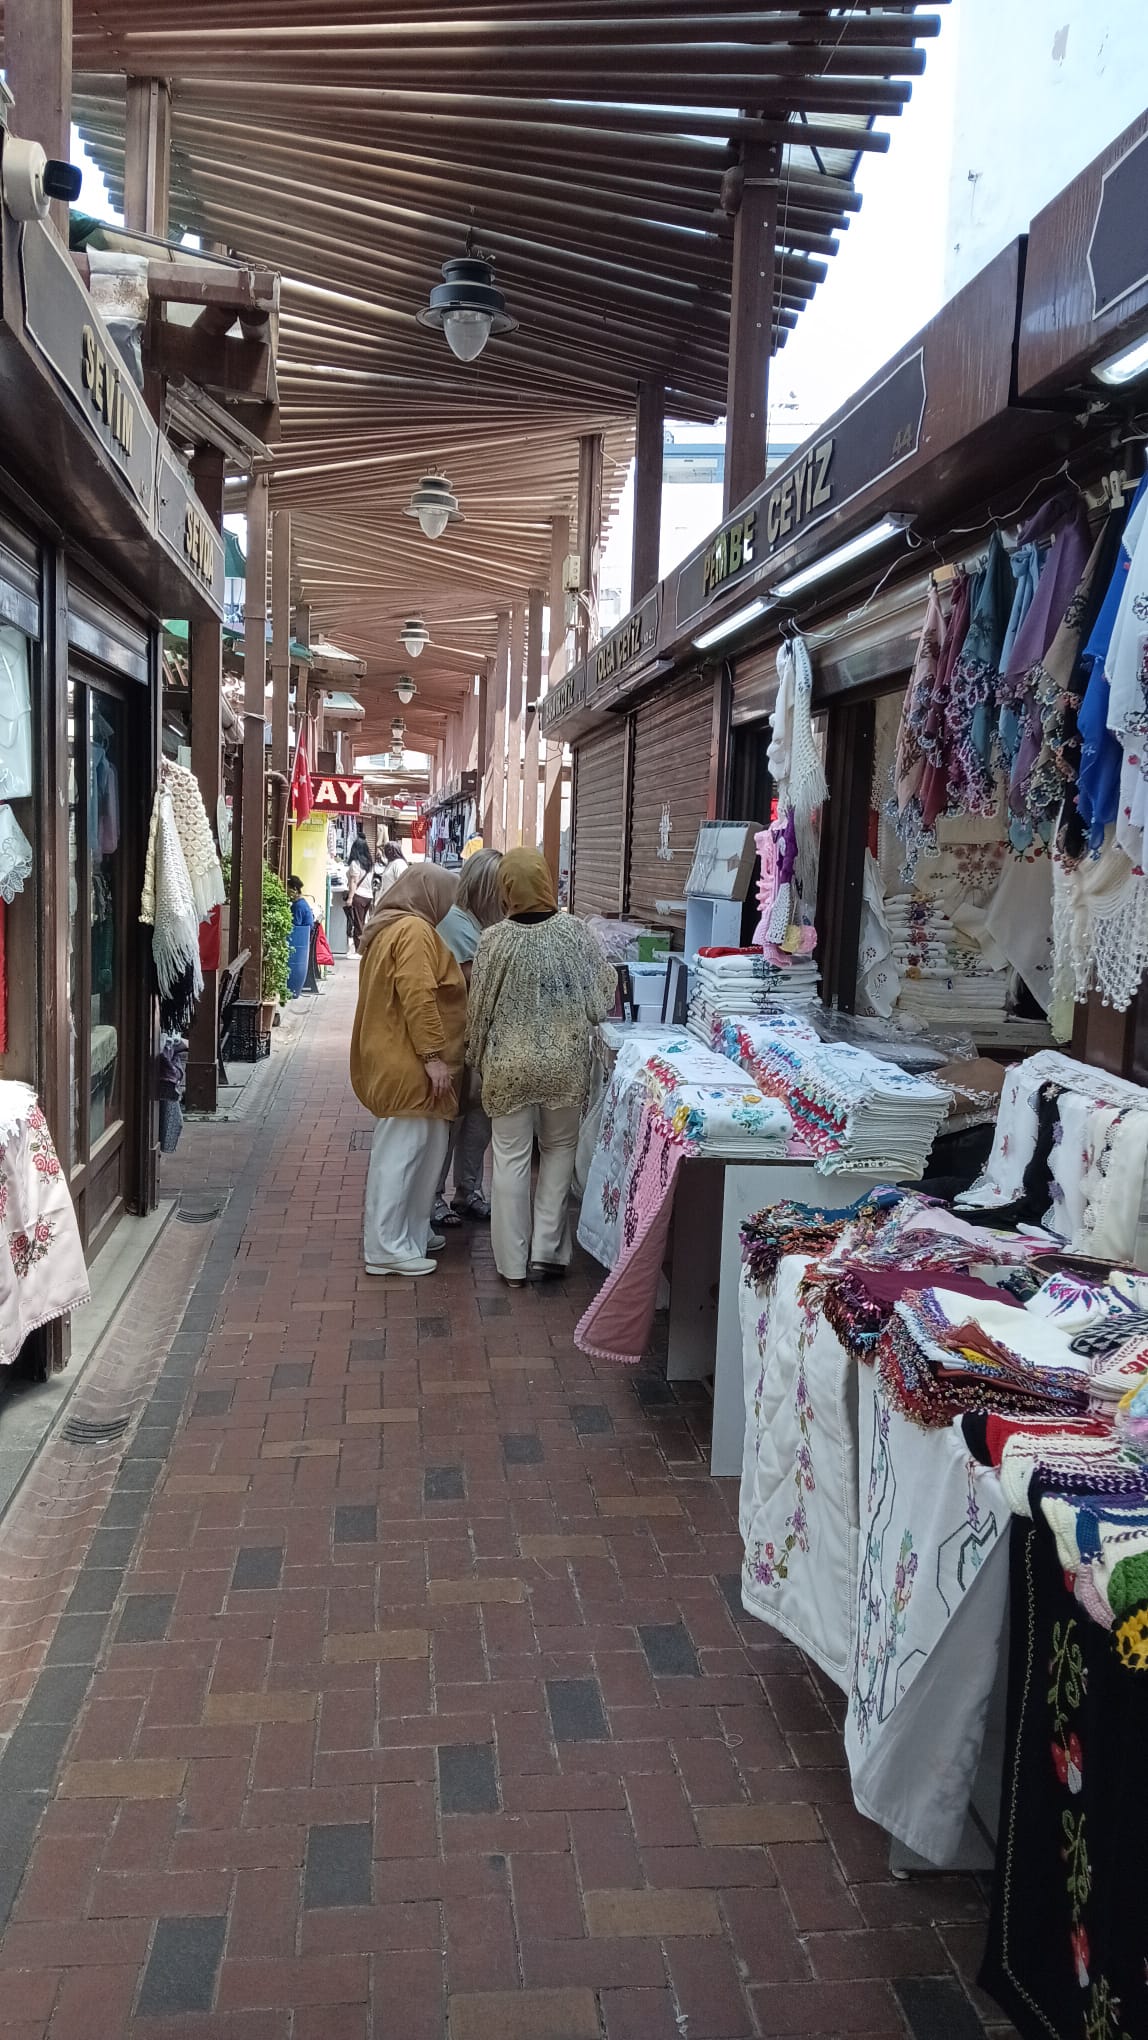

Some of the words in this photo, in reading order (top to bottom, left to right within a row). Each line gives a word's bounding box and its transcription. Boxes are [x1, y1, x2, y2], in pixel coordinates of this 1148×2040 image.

[82, 324, 134, 457] SEVİM
[184, 502, 214, 585] SEVDA
[702, 510, 757, 598] PEMBE
[766, 438, 836, 553] ÇEYİZ
[616, 614, 642, 670] ÇEYİZ
[311, 780, 361, 805] AY
